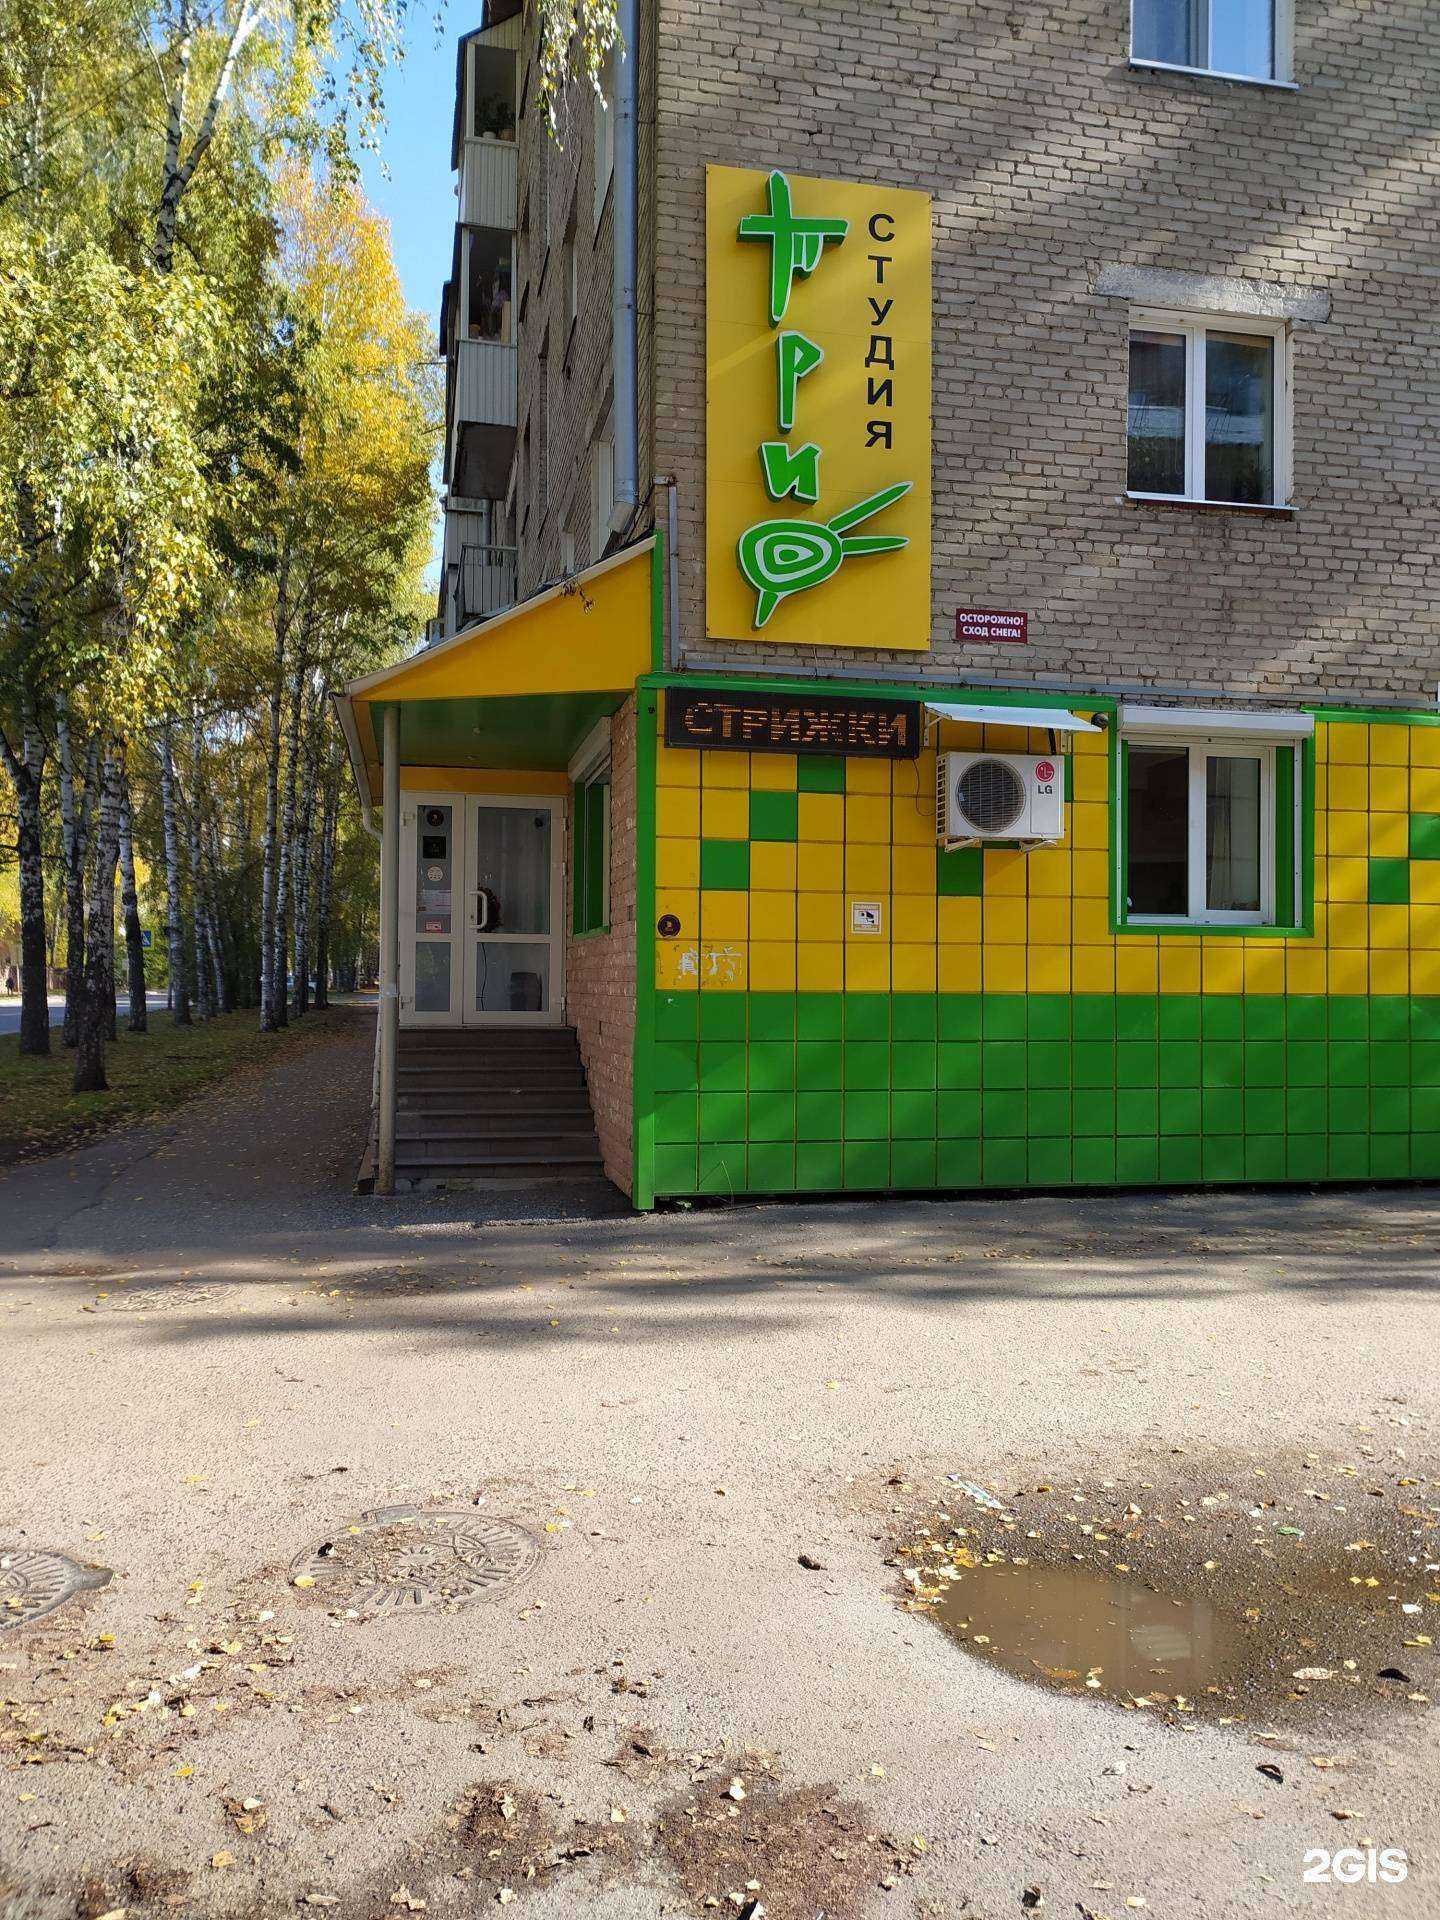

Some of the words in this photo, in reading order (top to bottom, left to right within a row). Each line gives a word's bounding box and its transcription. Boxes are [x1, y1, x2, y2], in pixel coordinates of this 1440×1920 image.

[864, 213, 895, 450] СТУДИЯ
[960, 613, 1024, 626] ОСТОРОЖНО!
[962, 625, 989, 637] СХОД
[990, 627, 1021, 638] СНЕГА!
[682, 702, 907, 747] СТРИЖКИ
[1037, 784, 1053, 795] LG
